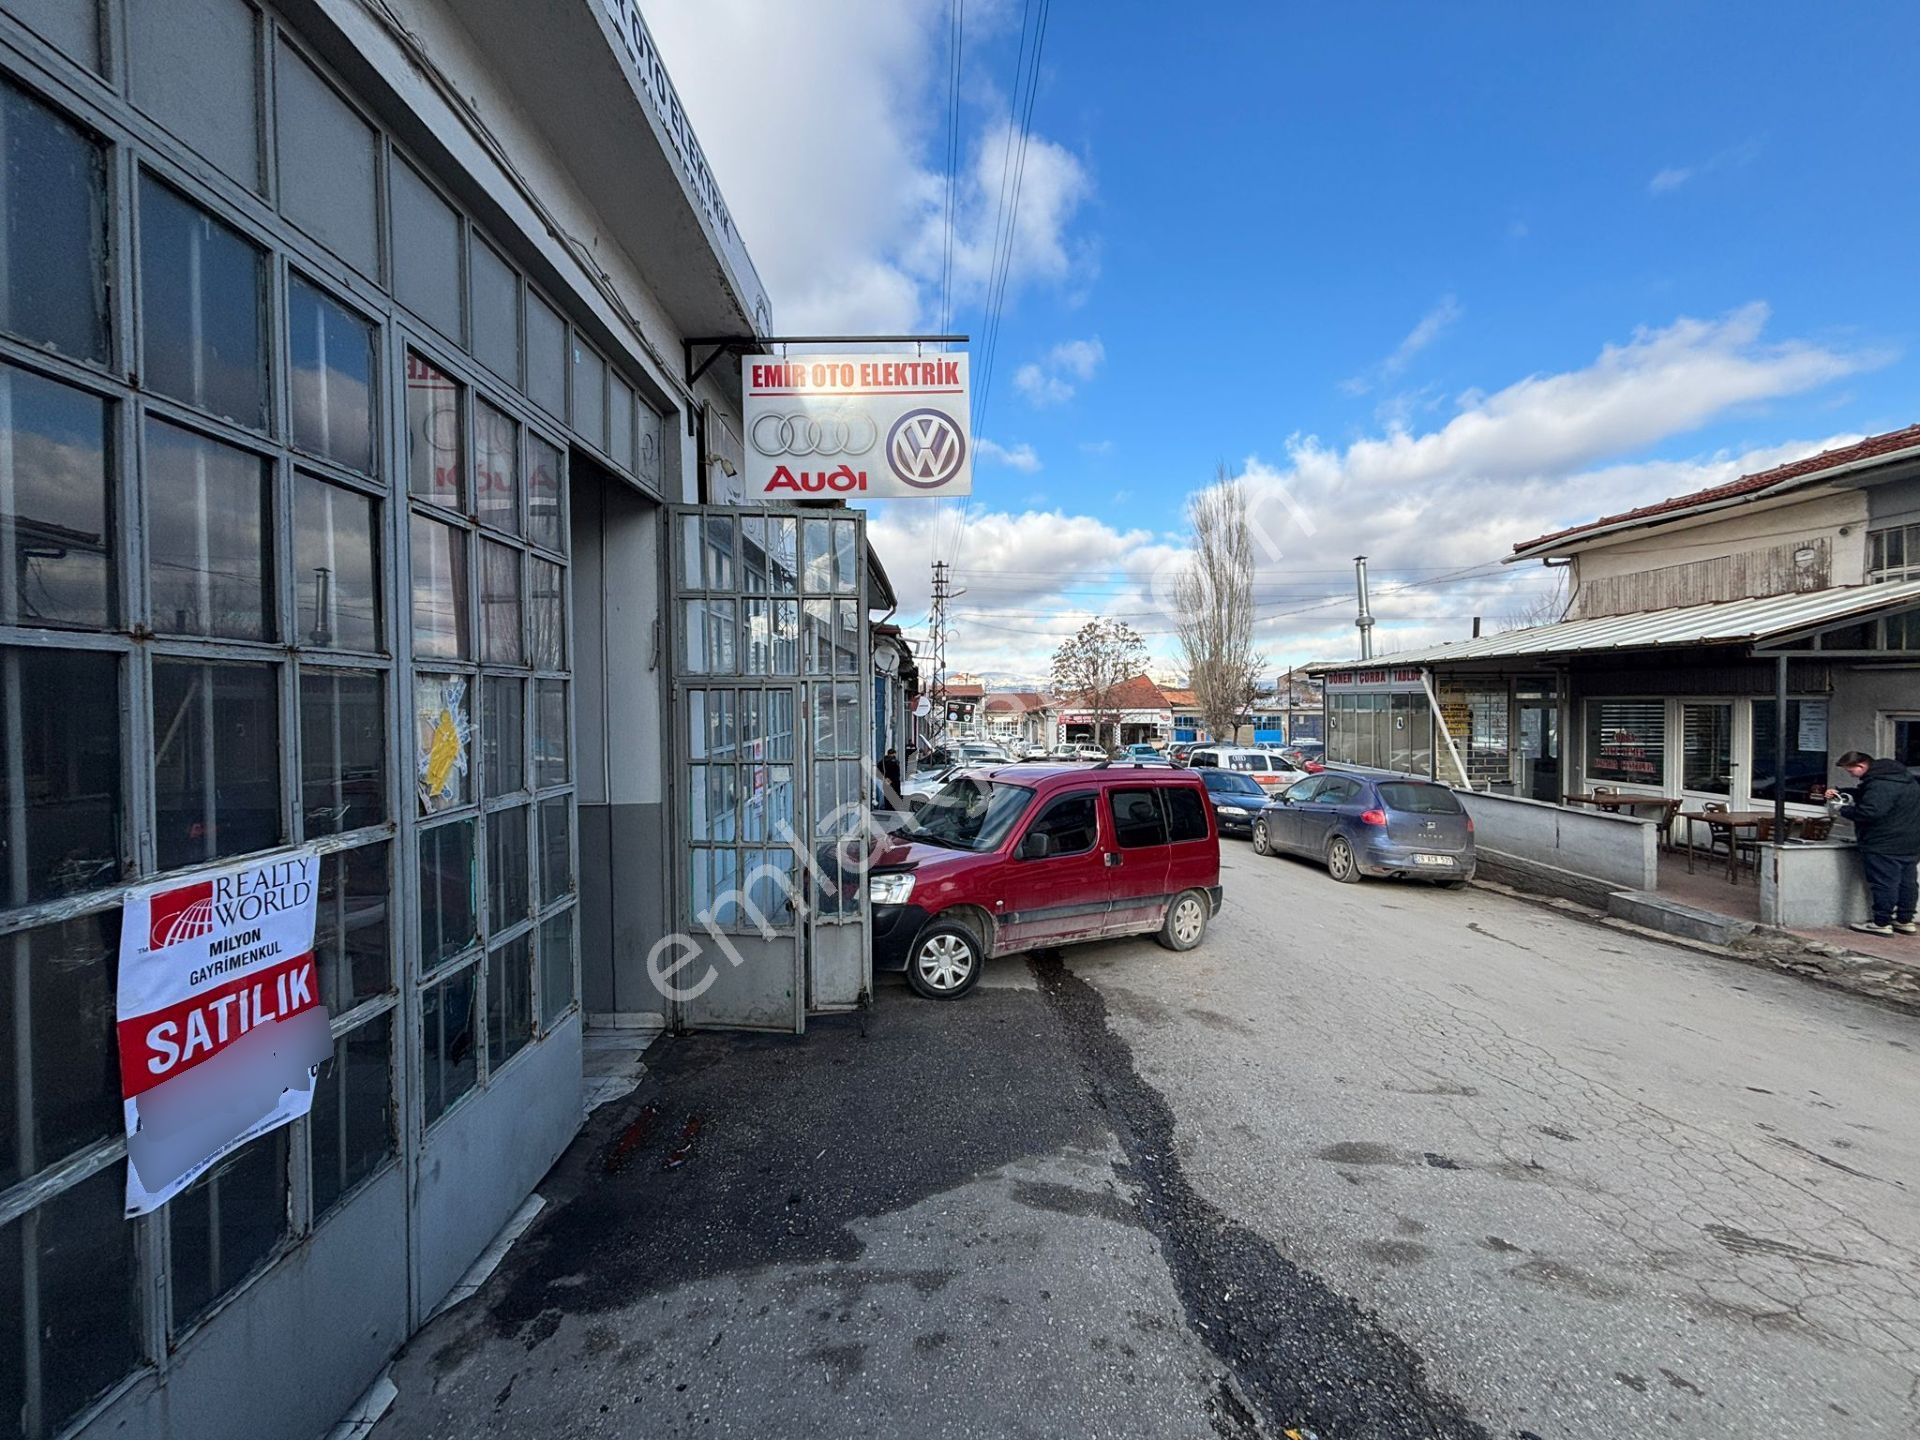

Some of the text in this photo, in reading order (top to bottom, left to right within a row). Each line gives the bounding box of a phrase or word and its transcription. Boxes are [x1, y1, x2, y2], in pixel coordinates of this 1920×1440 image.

[630, 10, 666, 106] OTO
[752, 358, 960, 388] EMİR OTO ELEKTRİK
[1328, 667, 1422, 685] DÖNER ÇORBA TABLDO
[215, 857, 309, 903] REALTY
[215, 881, 310, 929] WORLD
[189, 940, 282, 987] GAYRİMENKUL
[209, 928, 262, 958] MİLYON
[145, 962, 313, 1075] SATILIK
